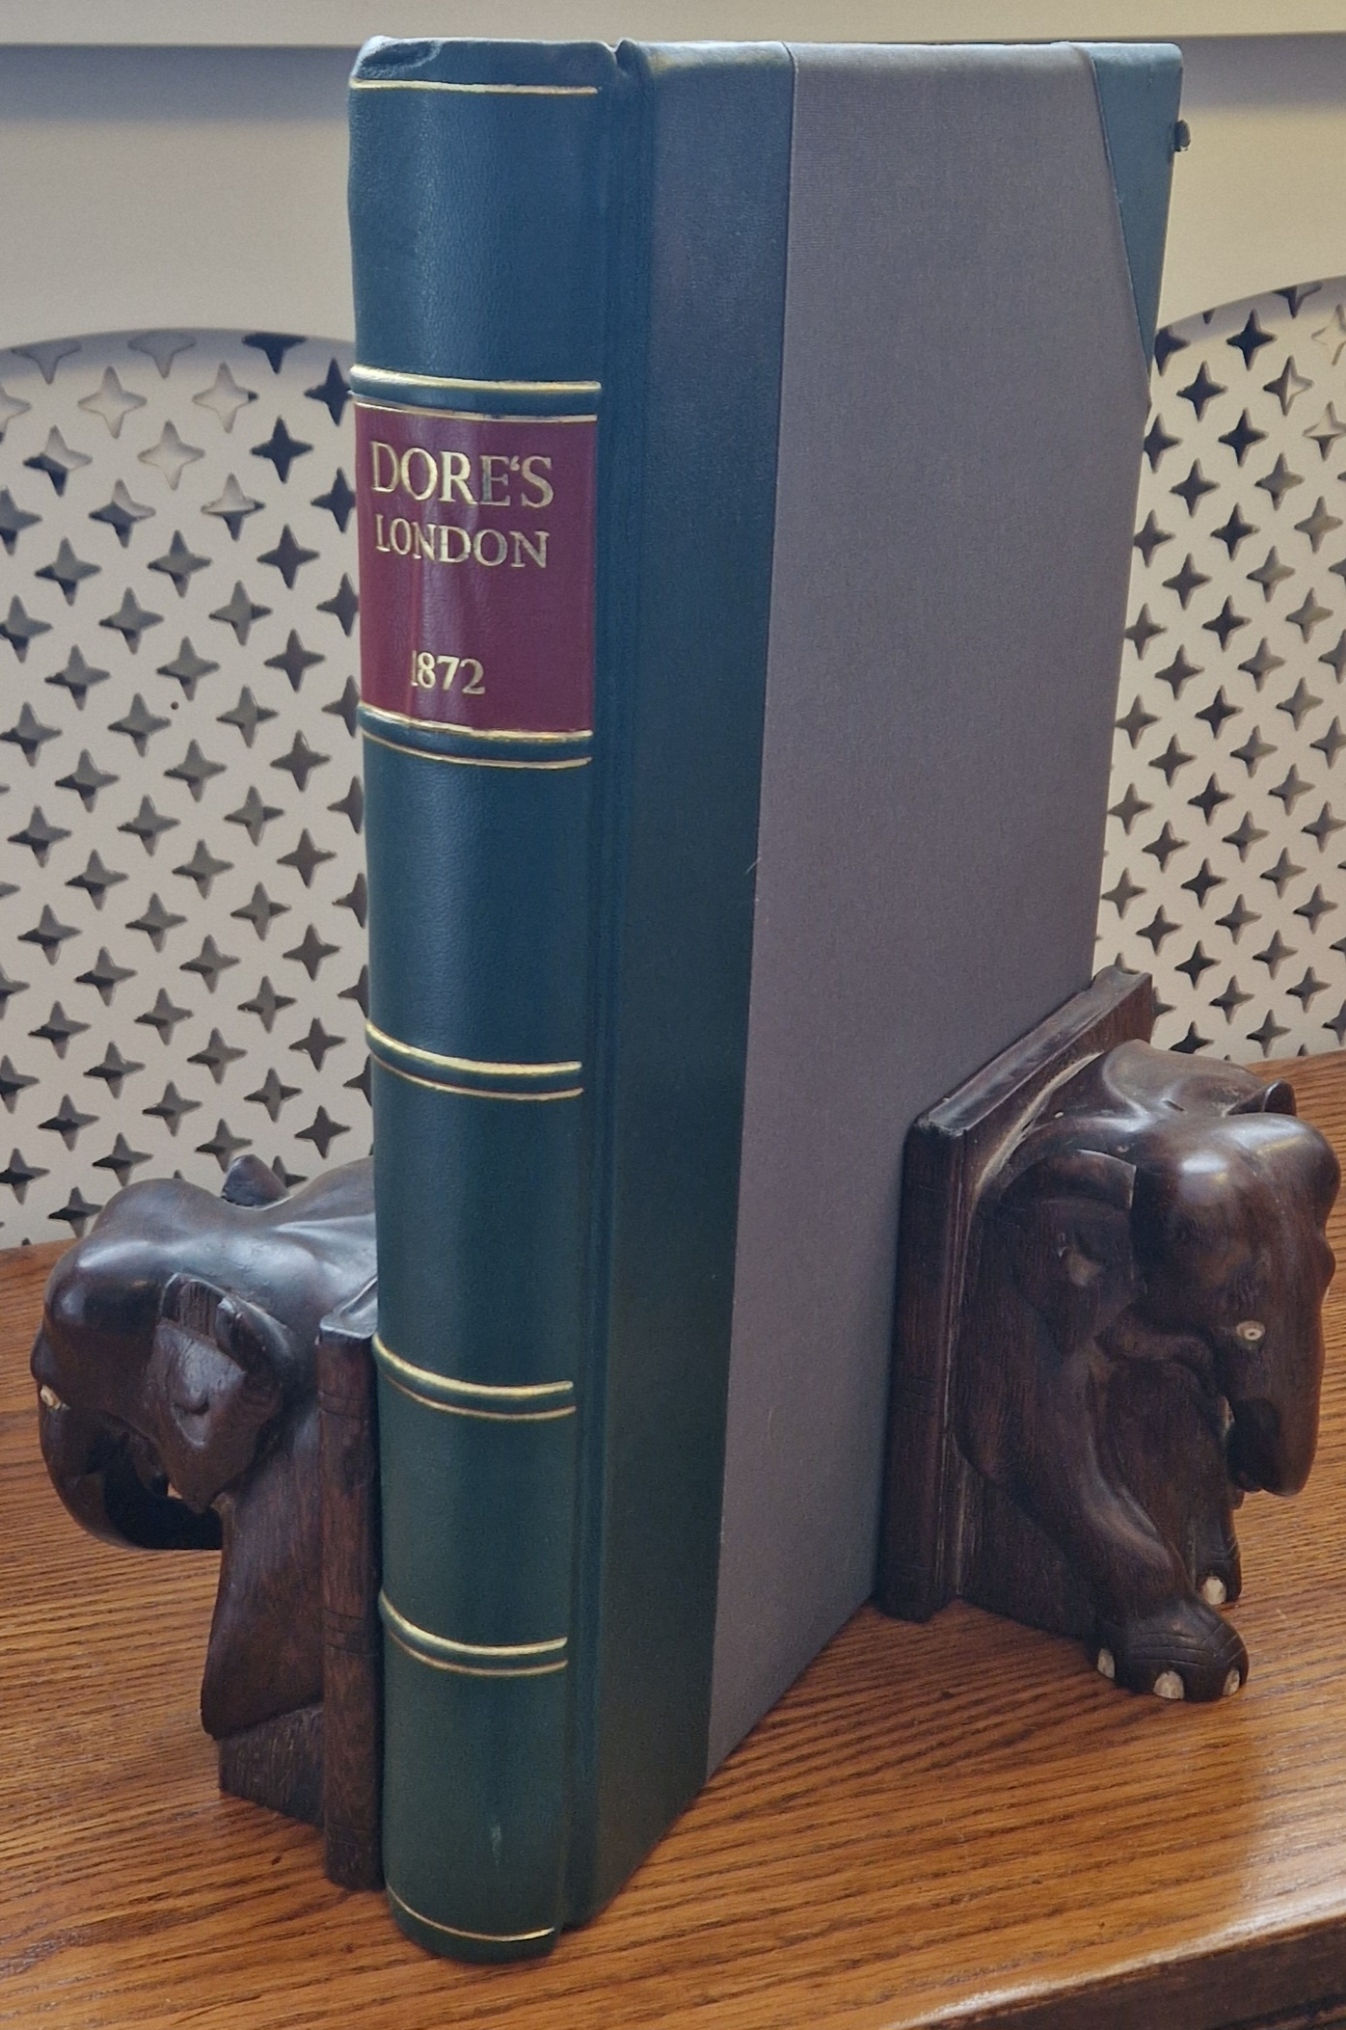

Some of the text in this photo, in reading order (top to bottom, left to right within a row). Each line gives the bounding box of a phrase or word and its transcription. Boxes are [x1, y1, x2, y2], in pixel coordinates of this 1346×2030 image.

[370, 441, 554, 509] DORE'S
[375, 514, 550, 568] LONDON
[411, 650, 486, 695] 1872
